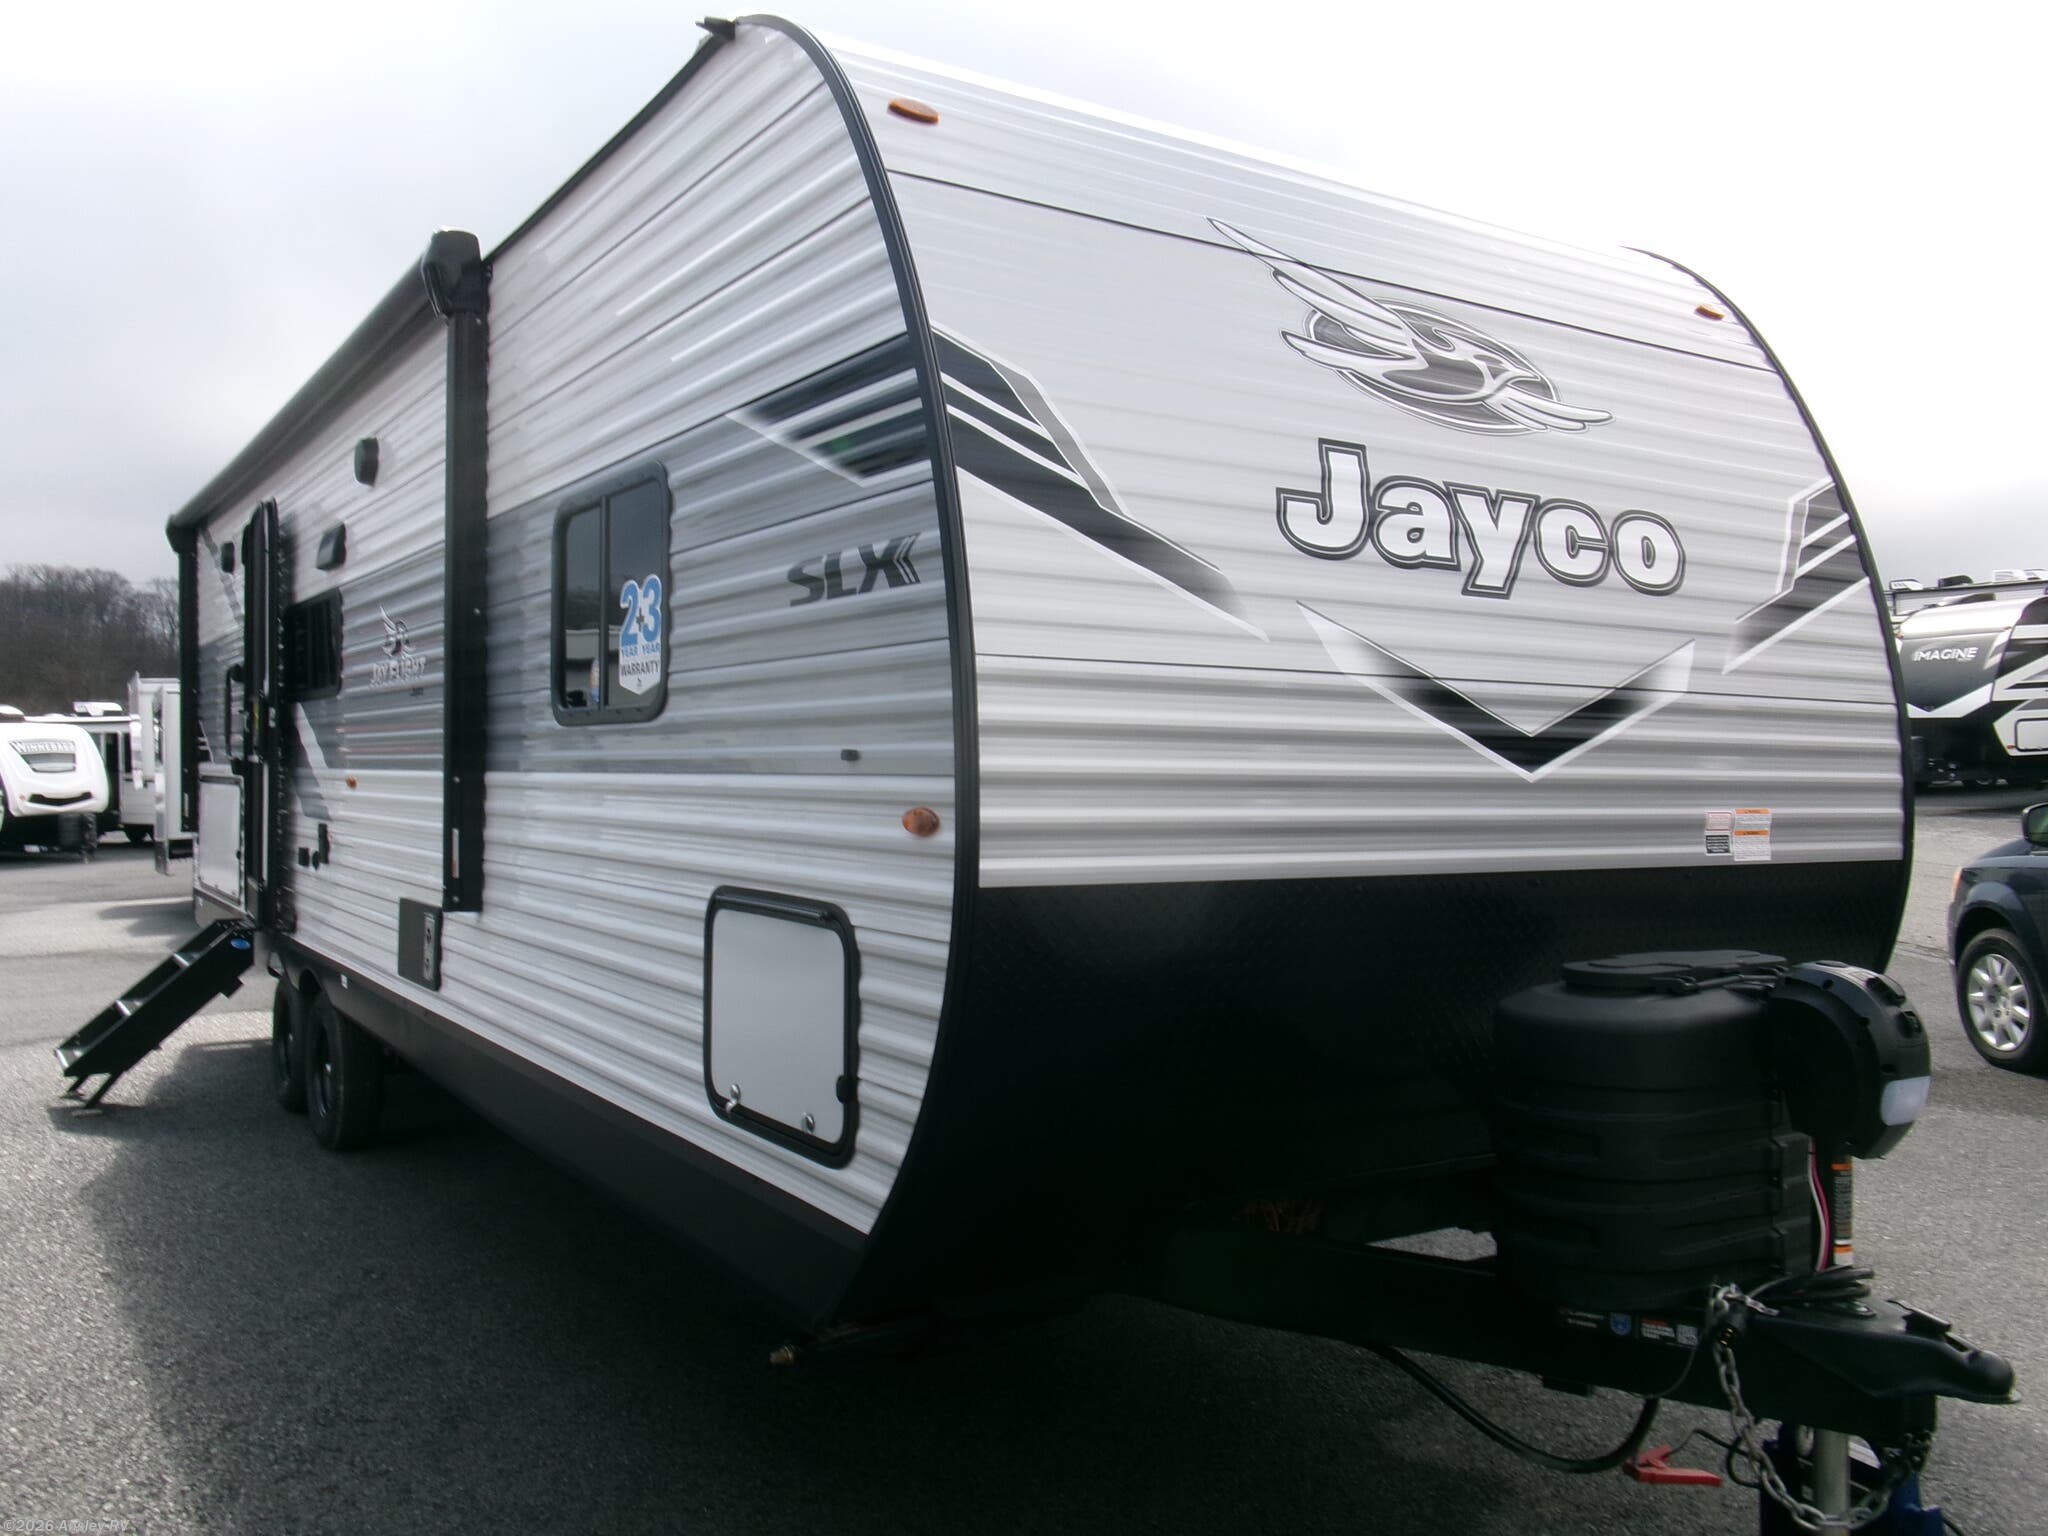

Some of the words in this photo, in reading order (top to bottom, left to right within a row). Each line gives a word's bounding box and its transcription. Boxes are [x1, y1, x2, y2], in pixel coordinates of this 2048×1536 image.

[1276, 438, 1687, 599] Jayco
[787, 533, 921, 606] SLX
[621, 645, 639, 657] YEAR
[641, 642, 660, 655] YEAR
[1912, 646, 1978, 661] IMAGINE
[620, 660, 659, 677] WARRANTY
